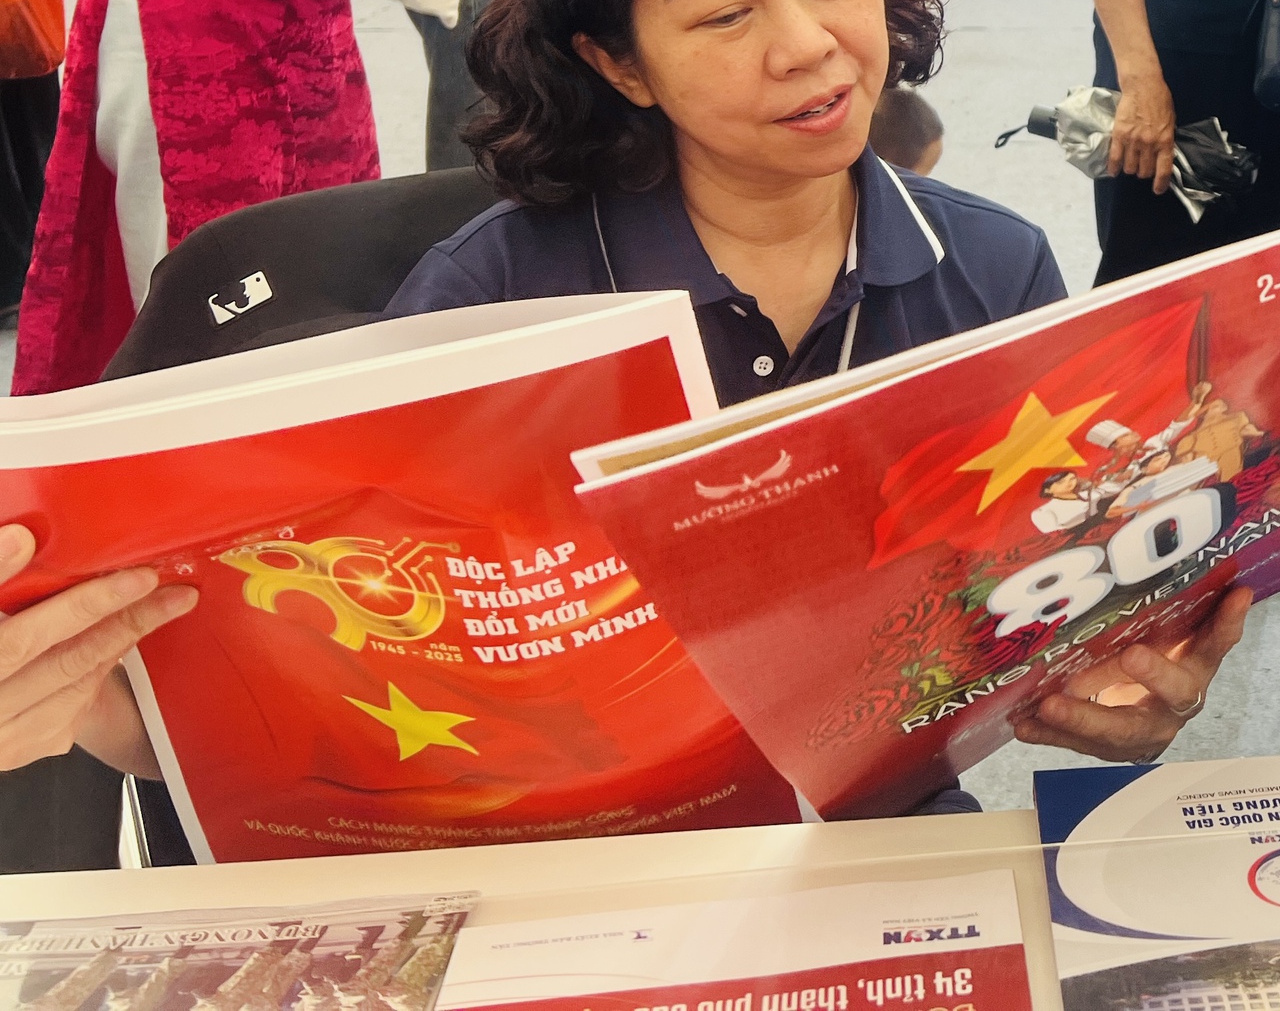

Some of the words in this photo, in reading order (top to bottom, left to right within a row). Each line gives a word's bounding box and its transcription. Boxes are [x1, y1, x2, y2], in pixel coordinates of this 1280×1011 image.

[757, 464, 840, 500] THANH
[445, 555, 506, 585] ĐỘC
[510, 541, 577, 575] LẬP
[453, 577, 566, 609] THỐNG
[463, 610, 519, 636] ĐỔI
[524, 598, 592, 632] MỚI
[472, 635, 566, 664] VƯƠN
[570, 601, 659, 648] MÌNH
[369, 640, 406, 655] 1945
[424, 649, 465, 663] 2025
[428, 642, 461, 653] năm
[1175, 792, 1216, 801] AGENCY
[1217, 788, 1246, 797] NEWS
[1181, 803, 1225, 817] TIỆN
[1218, 813, 1264, 829] QUỐC
[1185, 818, 1214, 829] GIA
[883, 925, 981, 946] TTXVN
[857, 973, 926, 1006] tỉnh,
[933, 968, 973, 997] 34
